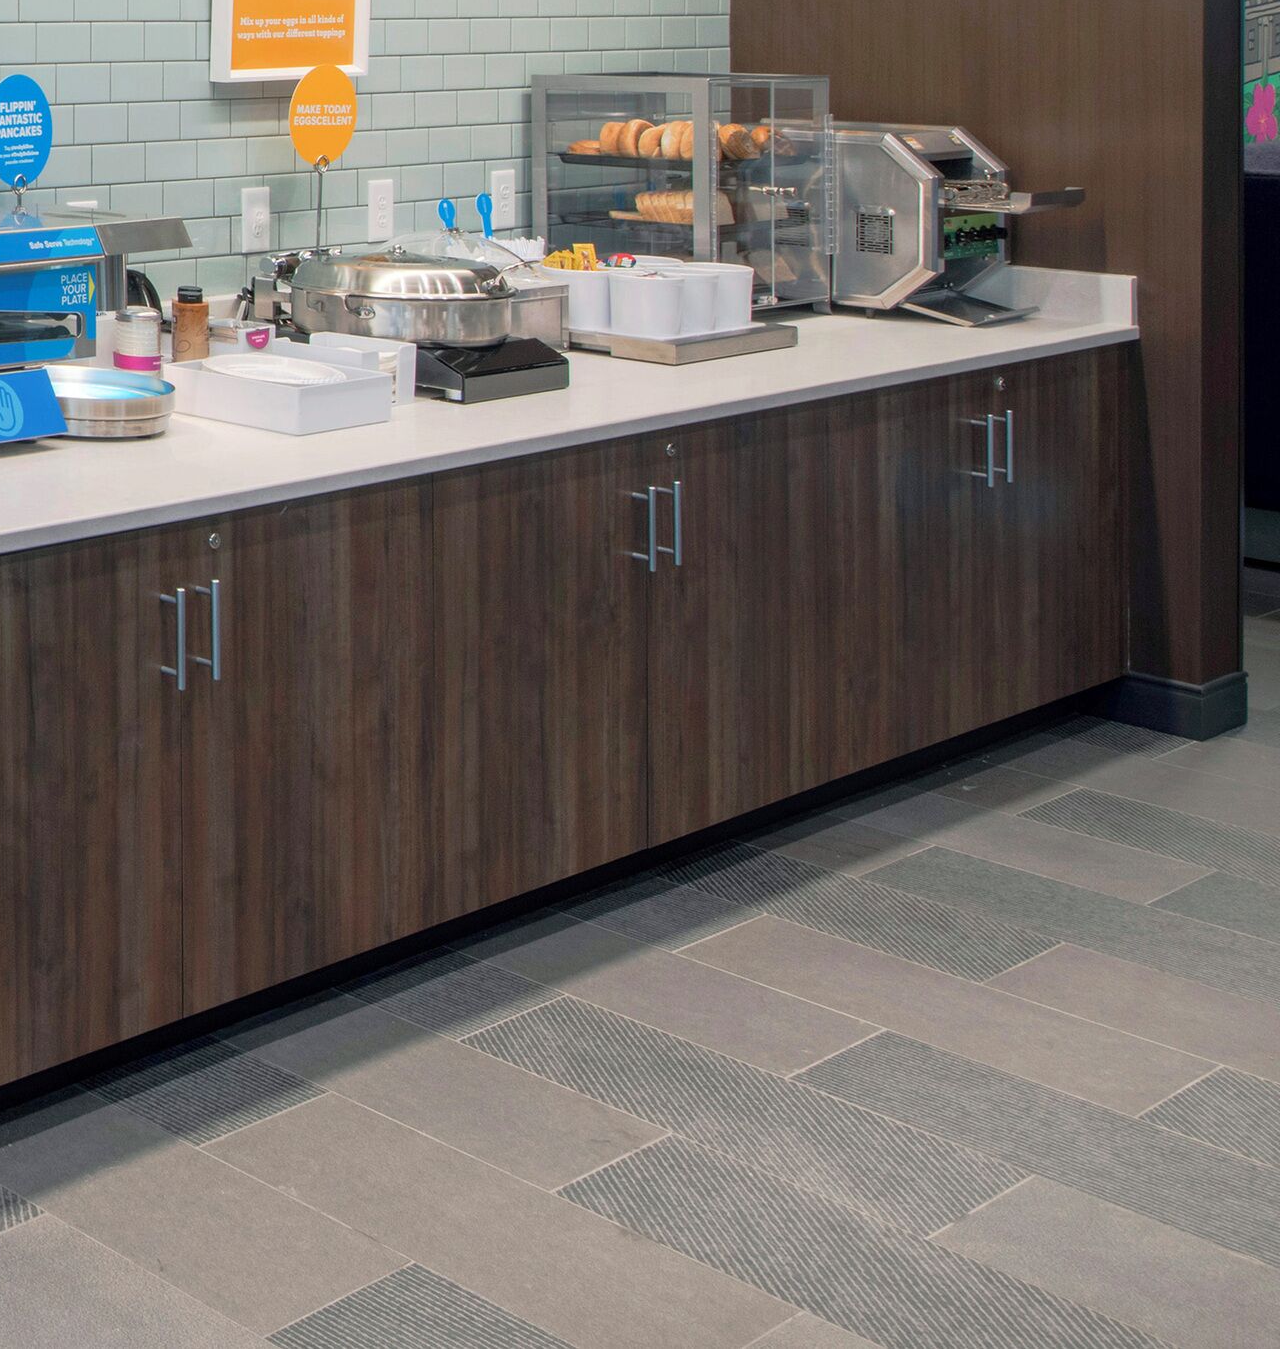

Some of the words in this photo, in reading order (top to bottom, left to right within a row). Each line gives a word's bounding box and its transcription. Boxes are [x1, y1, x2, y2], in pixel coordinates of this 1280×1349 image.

[240, 17, 254, 26] Mix
[255, 18, 264, 28] up
[265, 18, 281, 28] your
[283, 17, 298, 27] eggs
[317, 14, 335, 24] kinds
[285, 28, 316, 39] different
[316, 28, 346, 39] toppings
[0, 100, 37, 113] FLIPPIN'
[296, 104, 321, 114] MAKE
[324, 104, 352, 114] TODAY
[294, 116, 353, 126] EGGSCELLENT
[29, 241, 44, 250] Safe
[44, 239, 63, 249] Serve
[61, 273, 88, 285] PLACE
[62, 284, 86, 295] YOUR
[61, 294, 87, 306] PLATE
